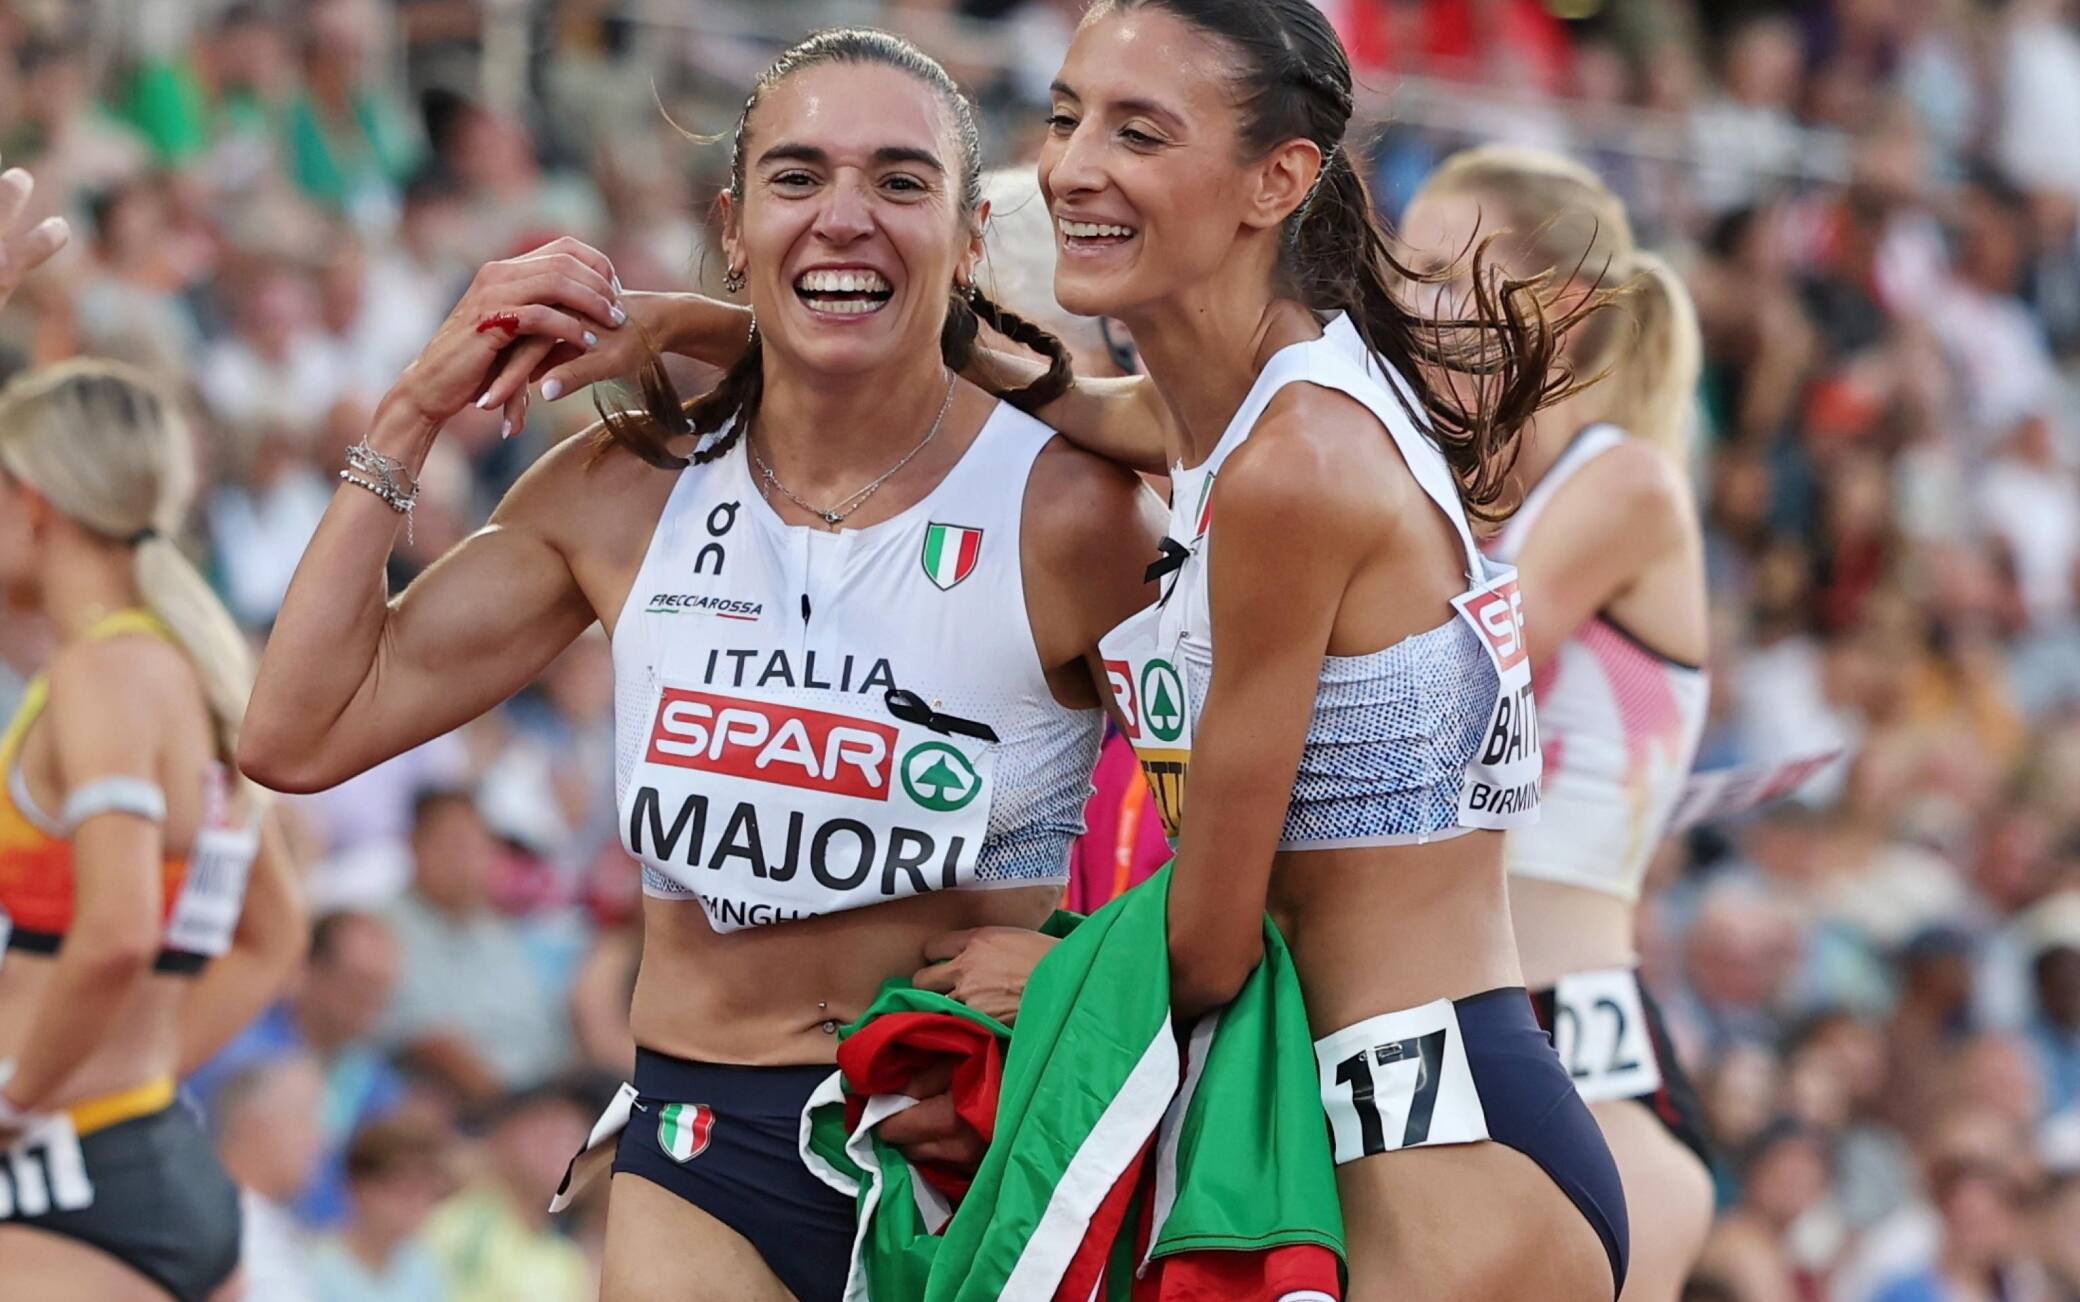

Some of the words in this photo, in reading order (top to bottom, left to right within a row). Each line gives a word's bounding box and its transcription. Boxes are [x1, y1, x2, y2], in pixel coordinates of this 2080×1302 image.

[649, 593, 763, 615] FRECCIAROSSA
[703, 648, 898, 695] ITALIA
[655, 699, 887, 788] SPAR
[630, 786, 966, 896] MAJORI
[1335, 1028, 1447, 1157] 17
